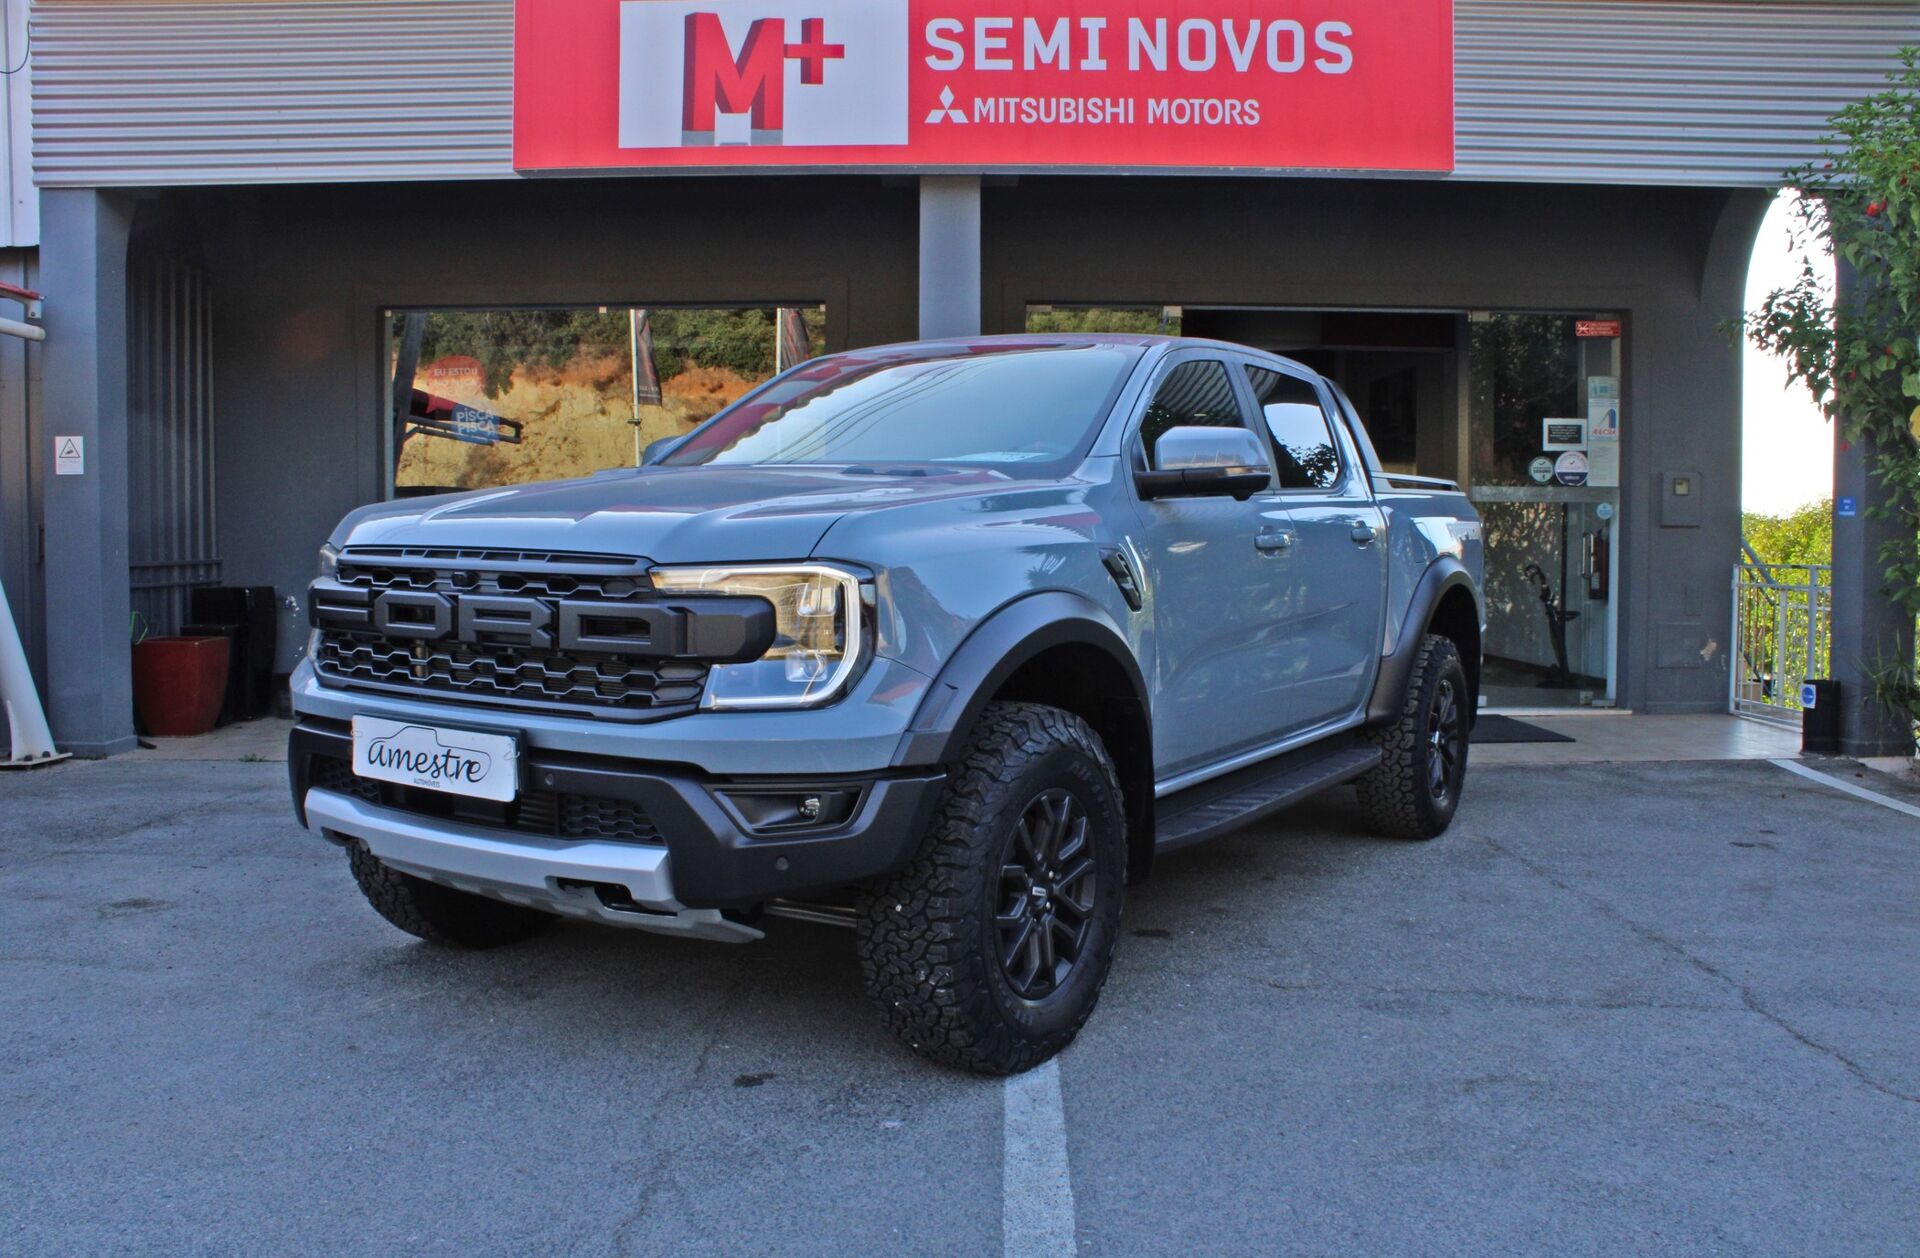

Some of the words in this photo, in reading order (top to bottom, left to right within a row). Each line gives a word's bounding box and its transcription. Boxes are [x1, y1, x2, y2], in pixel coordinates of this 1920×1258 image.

[924, 17, 1107, 71] SEMI
[1128, 18, 1354, 74] NOVOS
[974, 97, 1134, 124] MITSUBISHI
[1148, 98, 1260, 126] MOTORS
[308, 577, 690, 657] FORD
[368, 740, 482, 783] amestre
